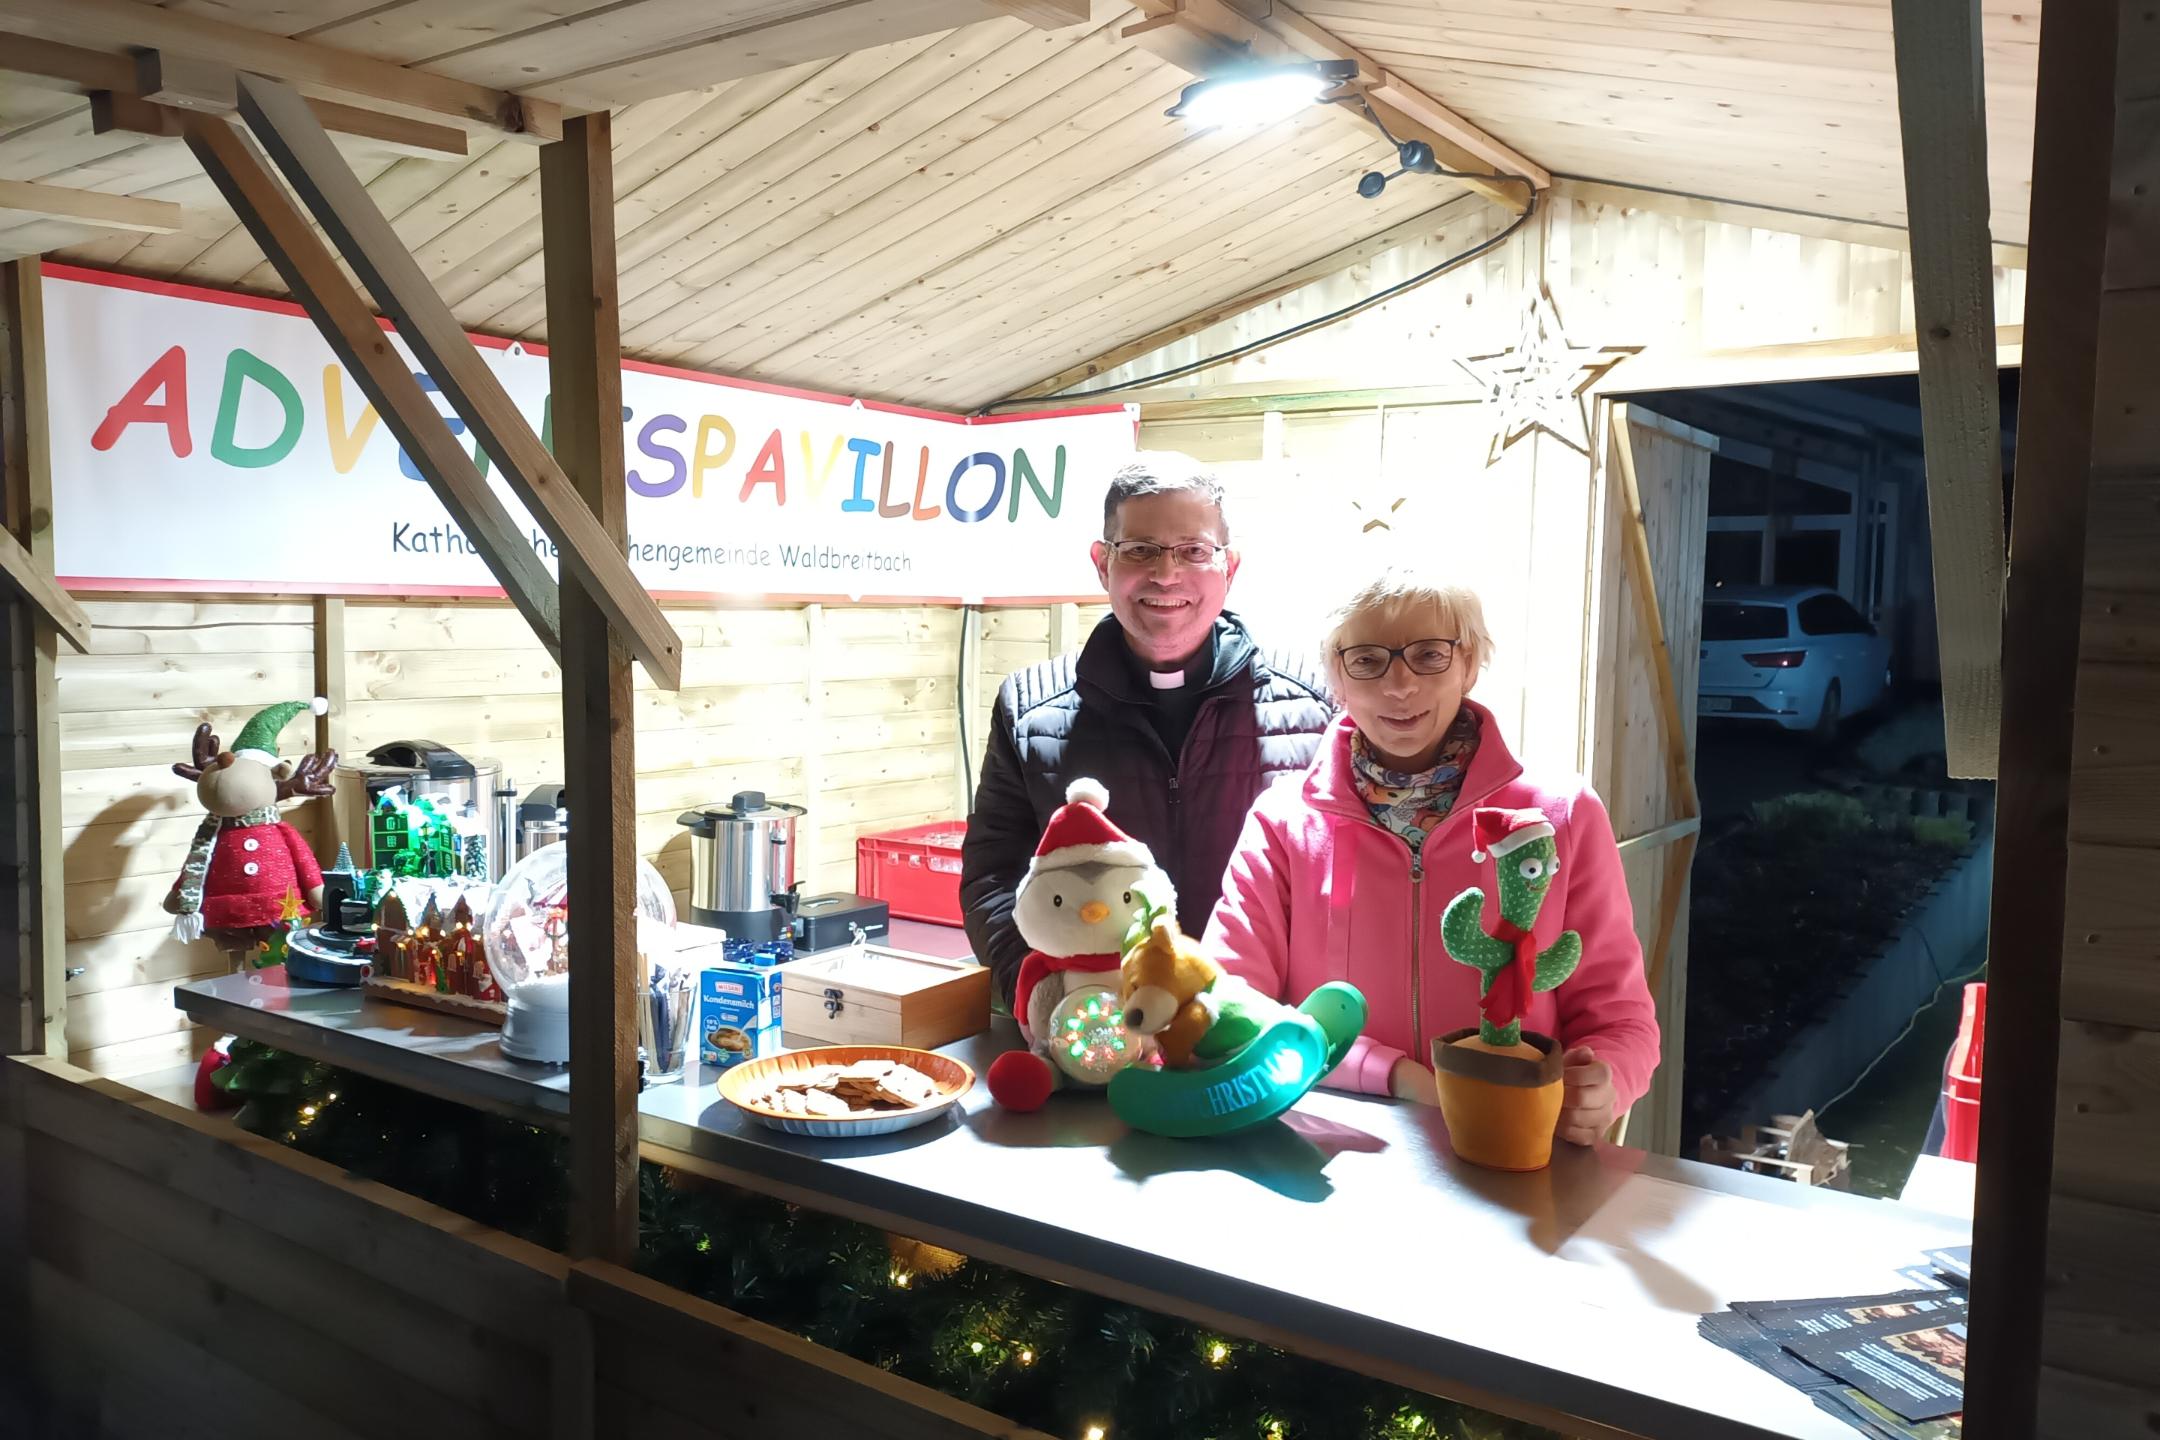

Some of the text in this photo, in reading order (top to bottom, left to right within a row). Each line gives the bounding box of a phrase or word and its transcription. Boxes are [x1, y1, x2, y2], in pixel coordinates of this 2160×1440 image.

[393, 521, 912, 572] Kathohe hengemeinde Waldbreitbach
[703, 994, 755, 1009] Kondensmilch
